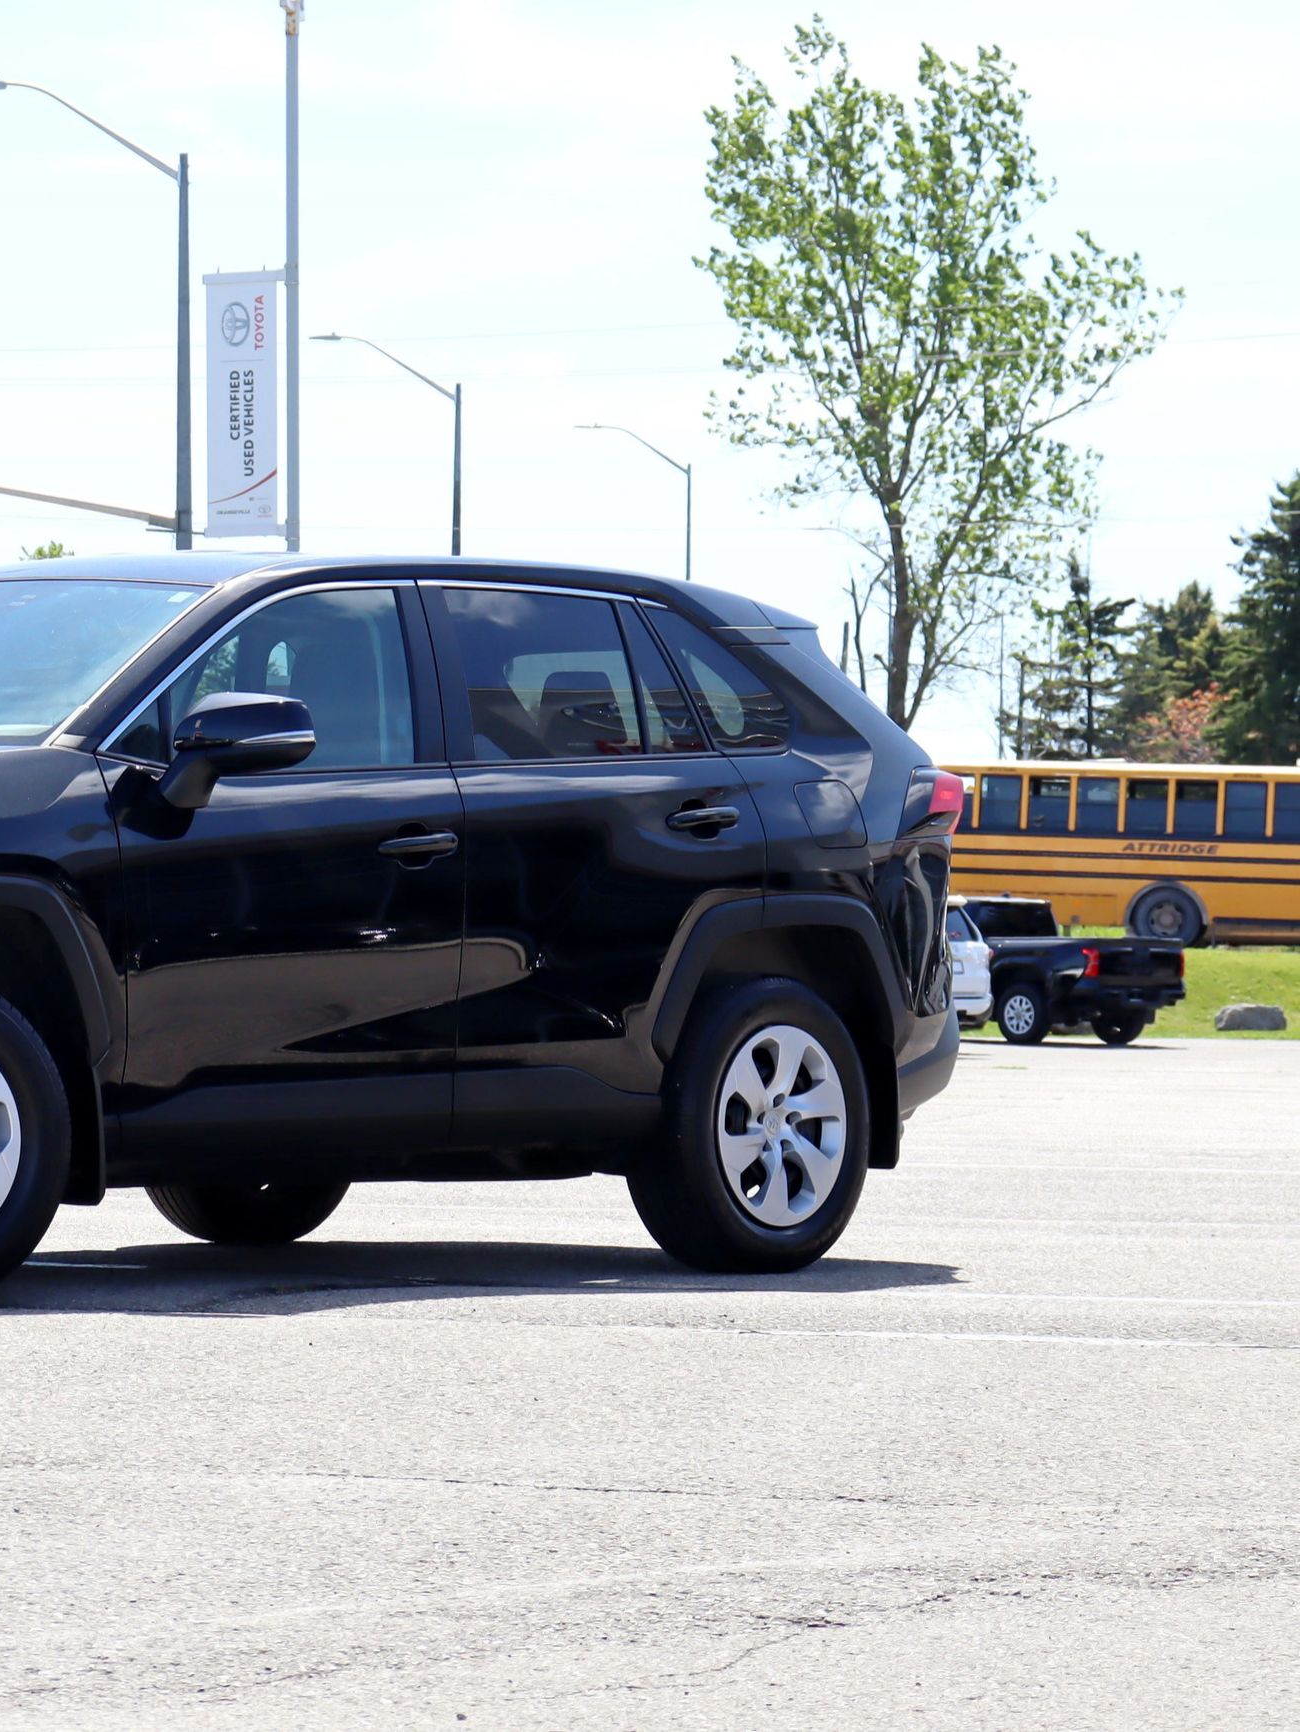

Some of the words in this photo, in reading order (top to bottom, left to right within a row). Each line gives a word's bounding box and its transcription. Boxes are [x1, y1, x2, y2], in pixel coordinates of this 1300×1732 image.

[254, 294, 265, 351] TOYOTA
[229, 370, 241, 441] CERTIFIED
[243, 369, 255, 437] VEHICLES
[243, 439, 255, 477] USED
[1123, 842, 1218, 854] ATTRIDGE
